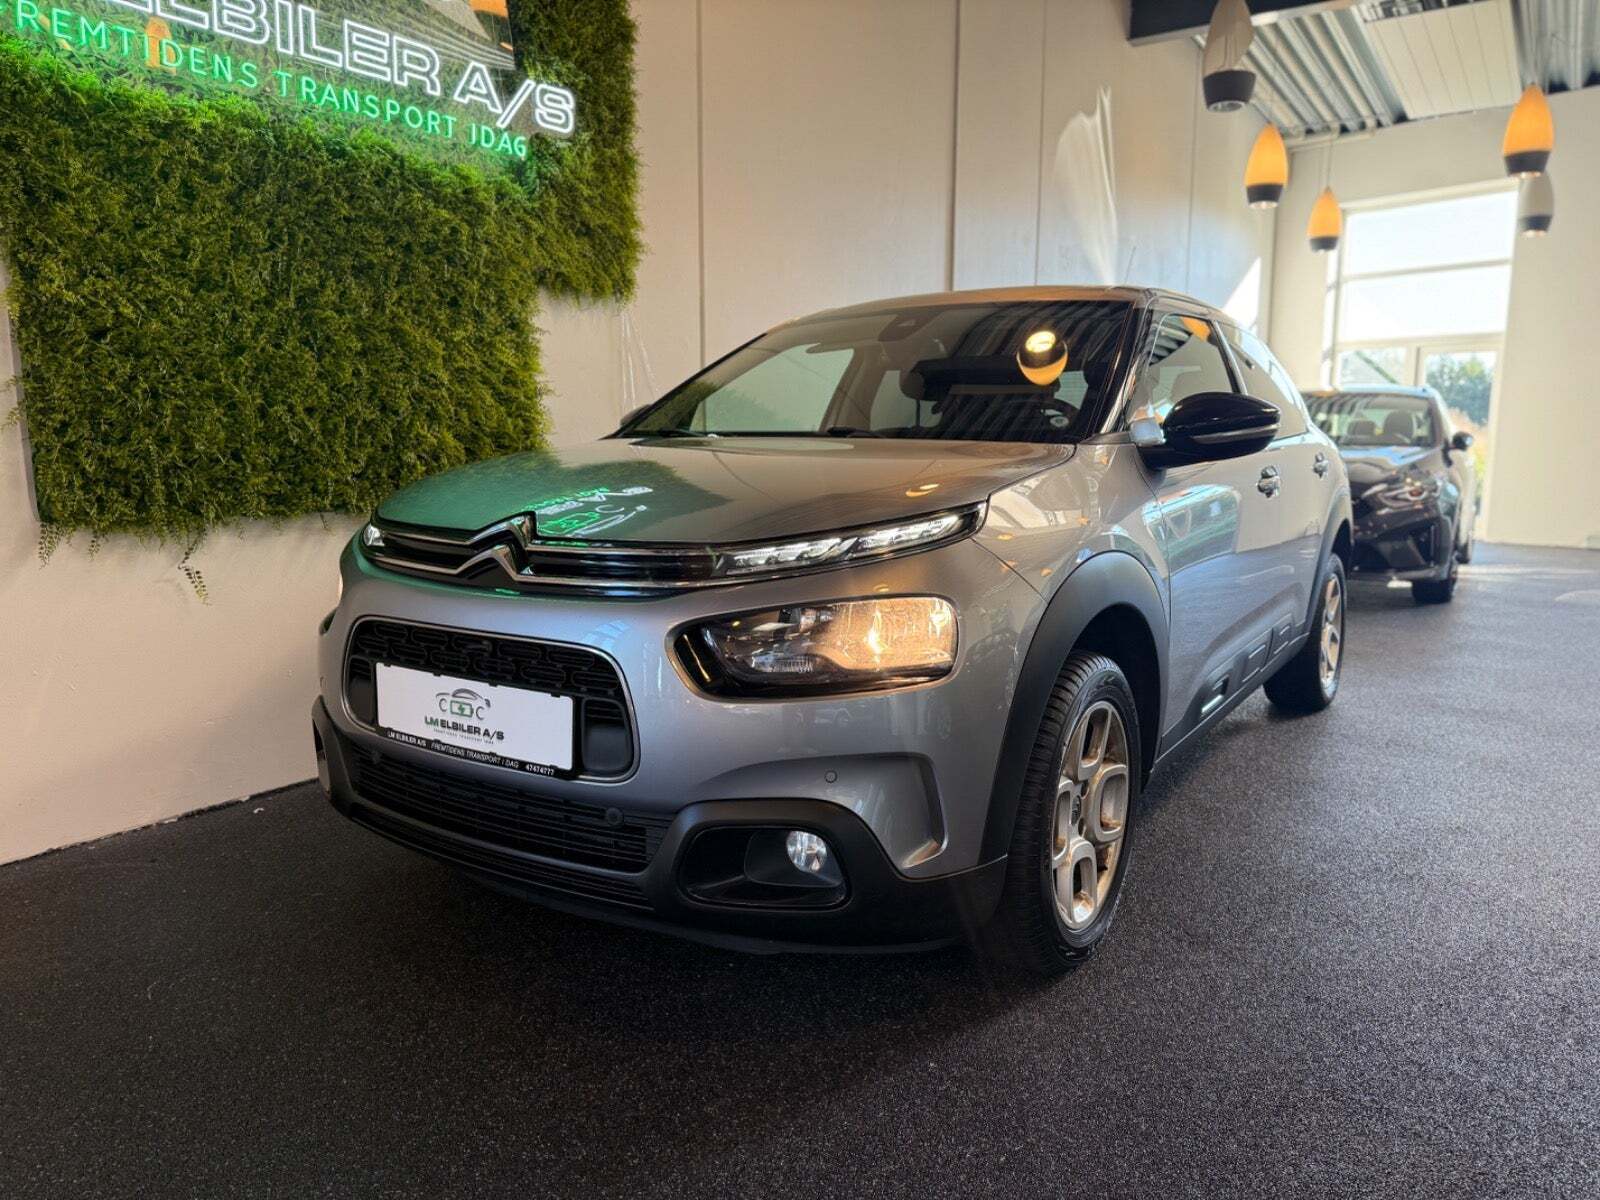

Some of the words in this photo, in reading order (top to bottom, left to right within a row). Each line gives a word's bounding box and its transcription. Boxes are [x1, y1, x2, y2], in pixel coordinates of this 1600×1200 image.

[0, 0, 259, 89] REMTIDENS
[272, 69, 457, 139] TRANSPORT
[112, 0, 442, 97] LBILER
[453, 60, 577, 134] A/S
[425, 716, 439, 727] LM
[440, 719, 481, 736] ELBILER
[482, 728, 505, 741] A/S
[466, 750, 501, 766] TRANSPORT
